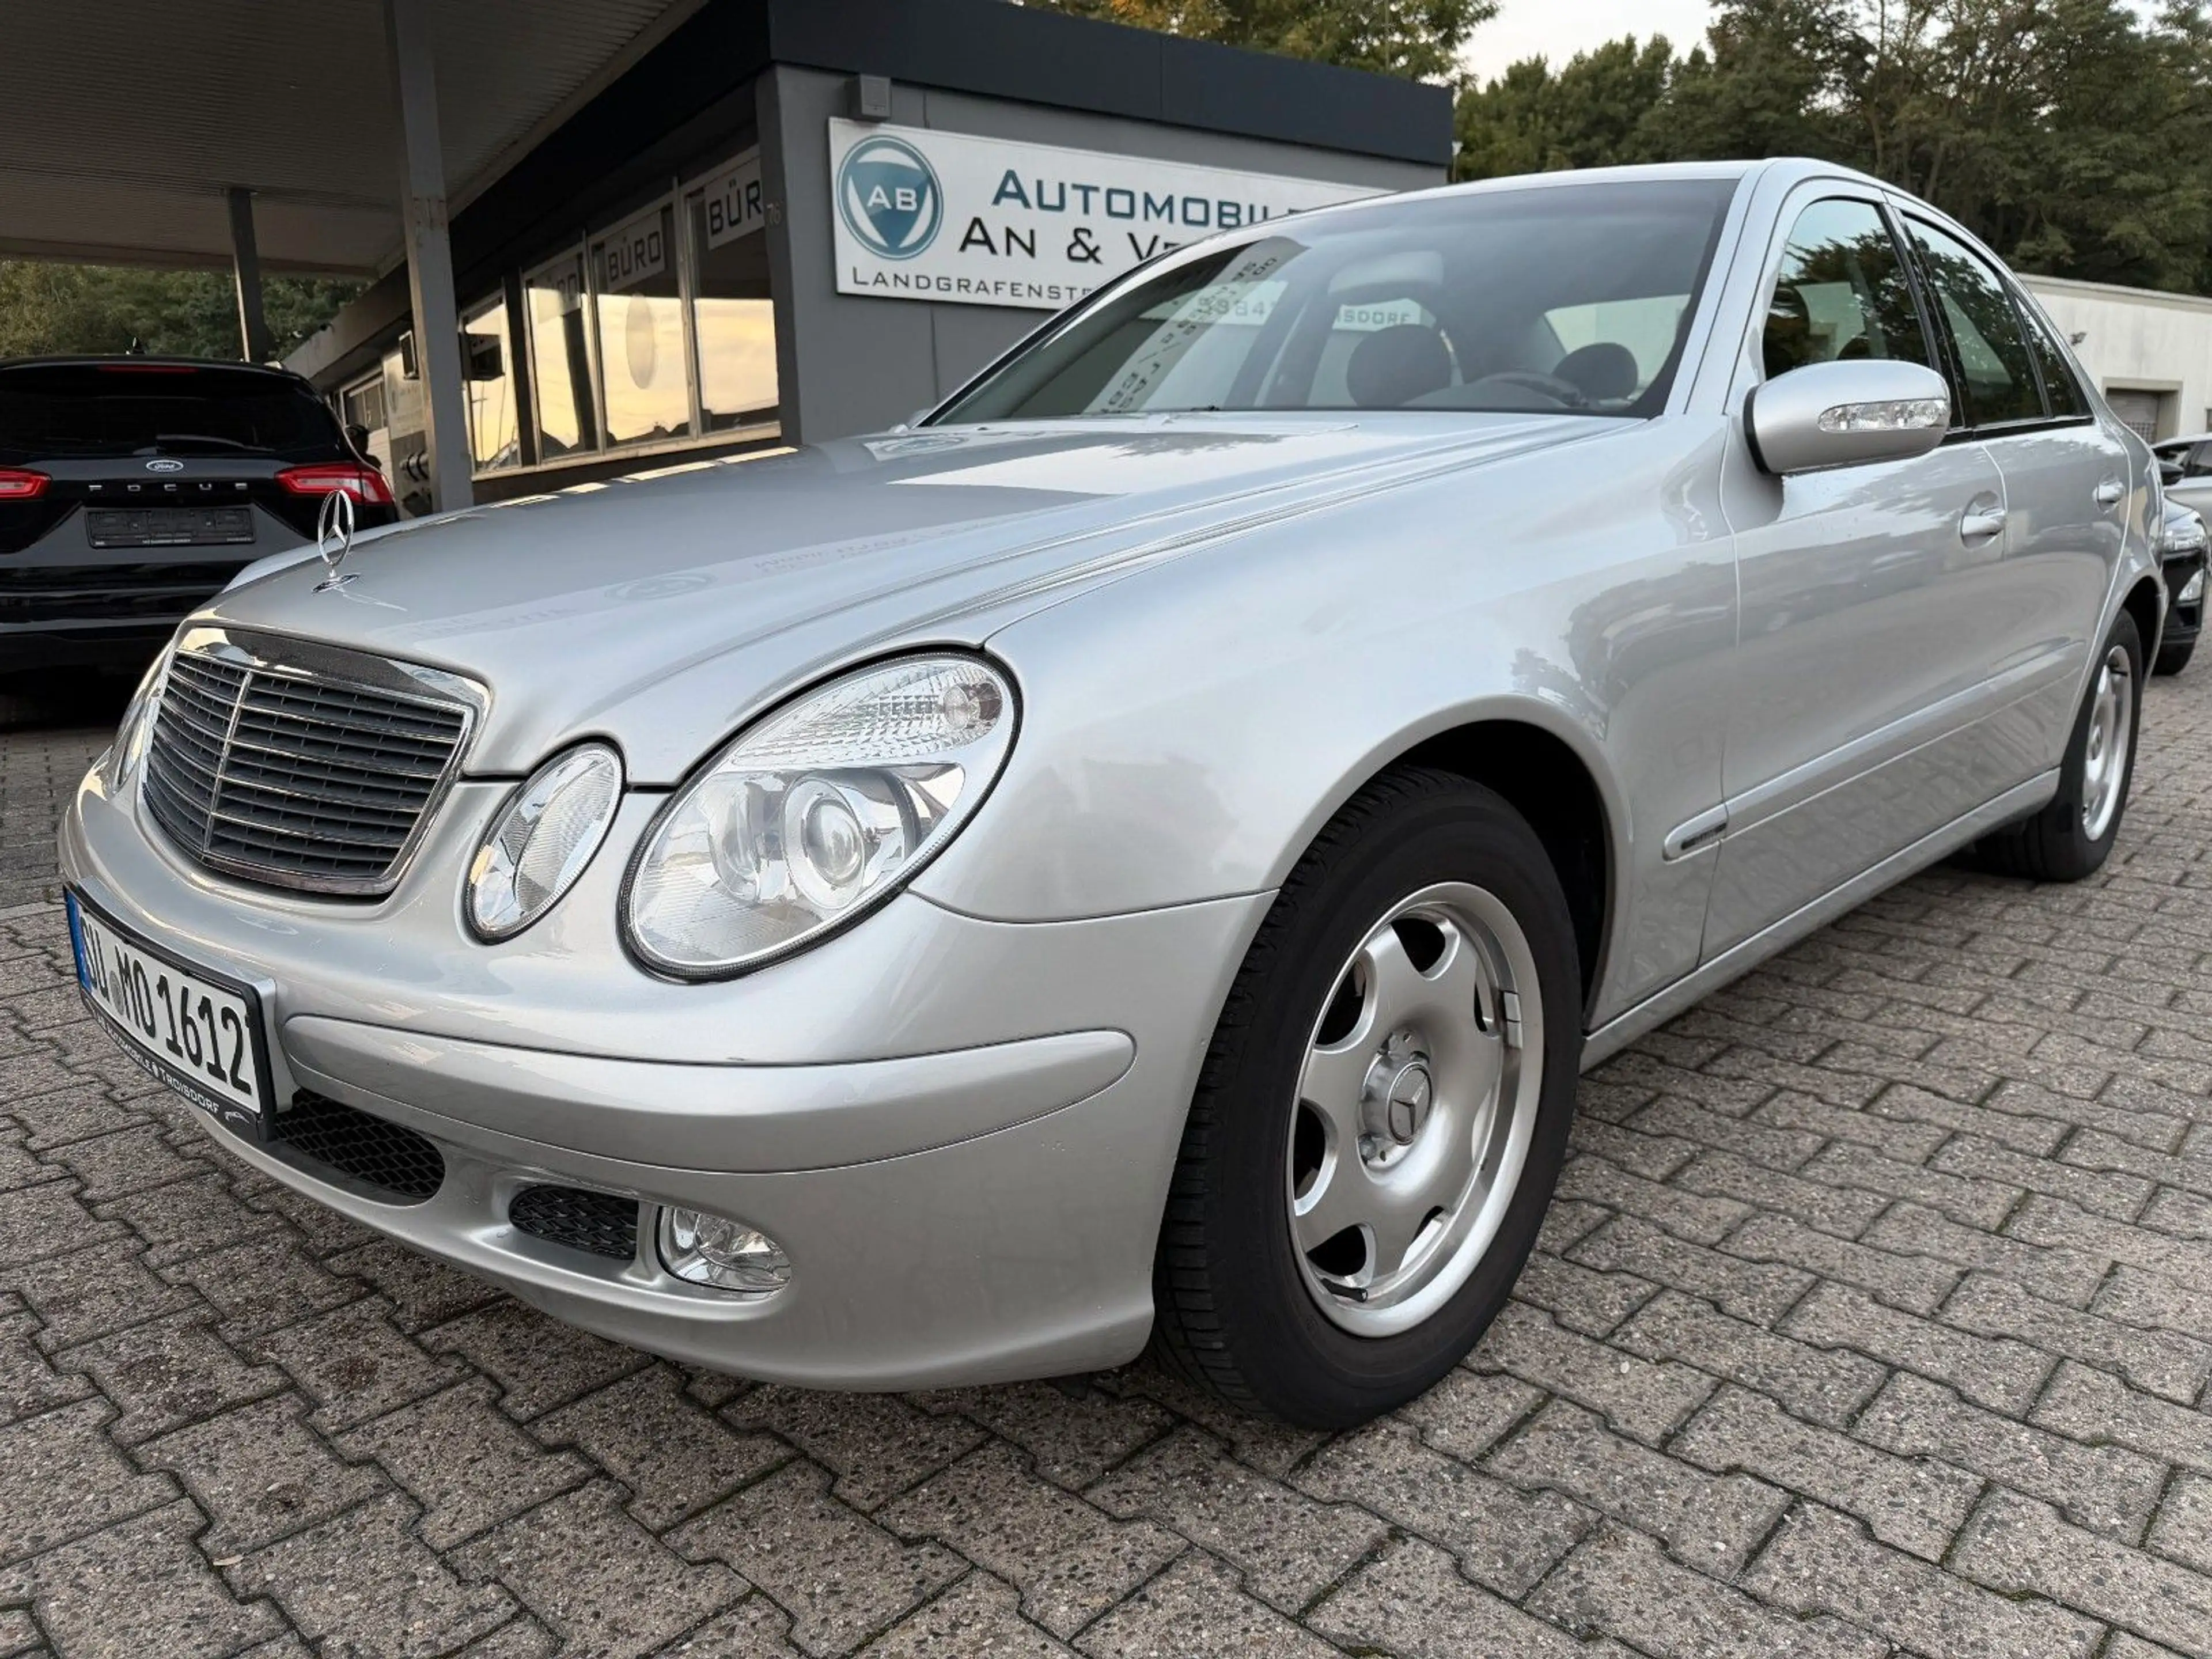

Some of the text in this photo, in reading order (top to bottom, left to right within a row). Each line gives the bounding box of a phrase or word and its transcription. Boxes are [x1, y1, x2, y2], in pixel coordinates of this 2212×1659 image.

[709, 178, 763, 236] BÜR
[867, 185, 918, 211] AB
[991, 169, 1305, 229] AUTOMOBI
[607, 231, 661, 283] BÜRO
[959, 217, 1180, 264] AN & V
[115, 945, 156, 1038] MO
[157, 974, 252, 1096] 1612
